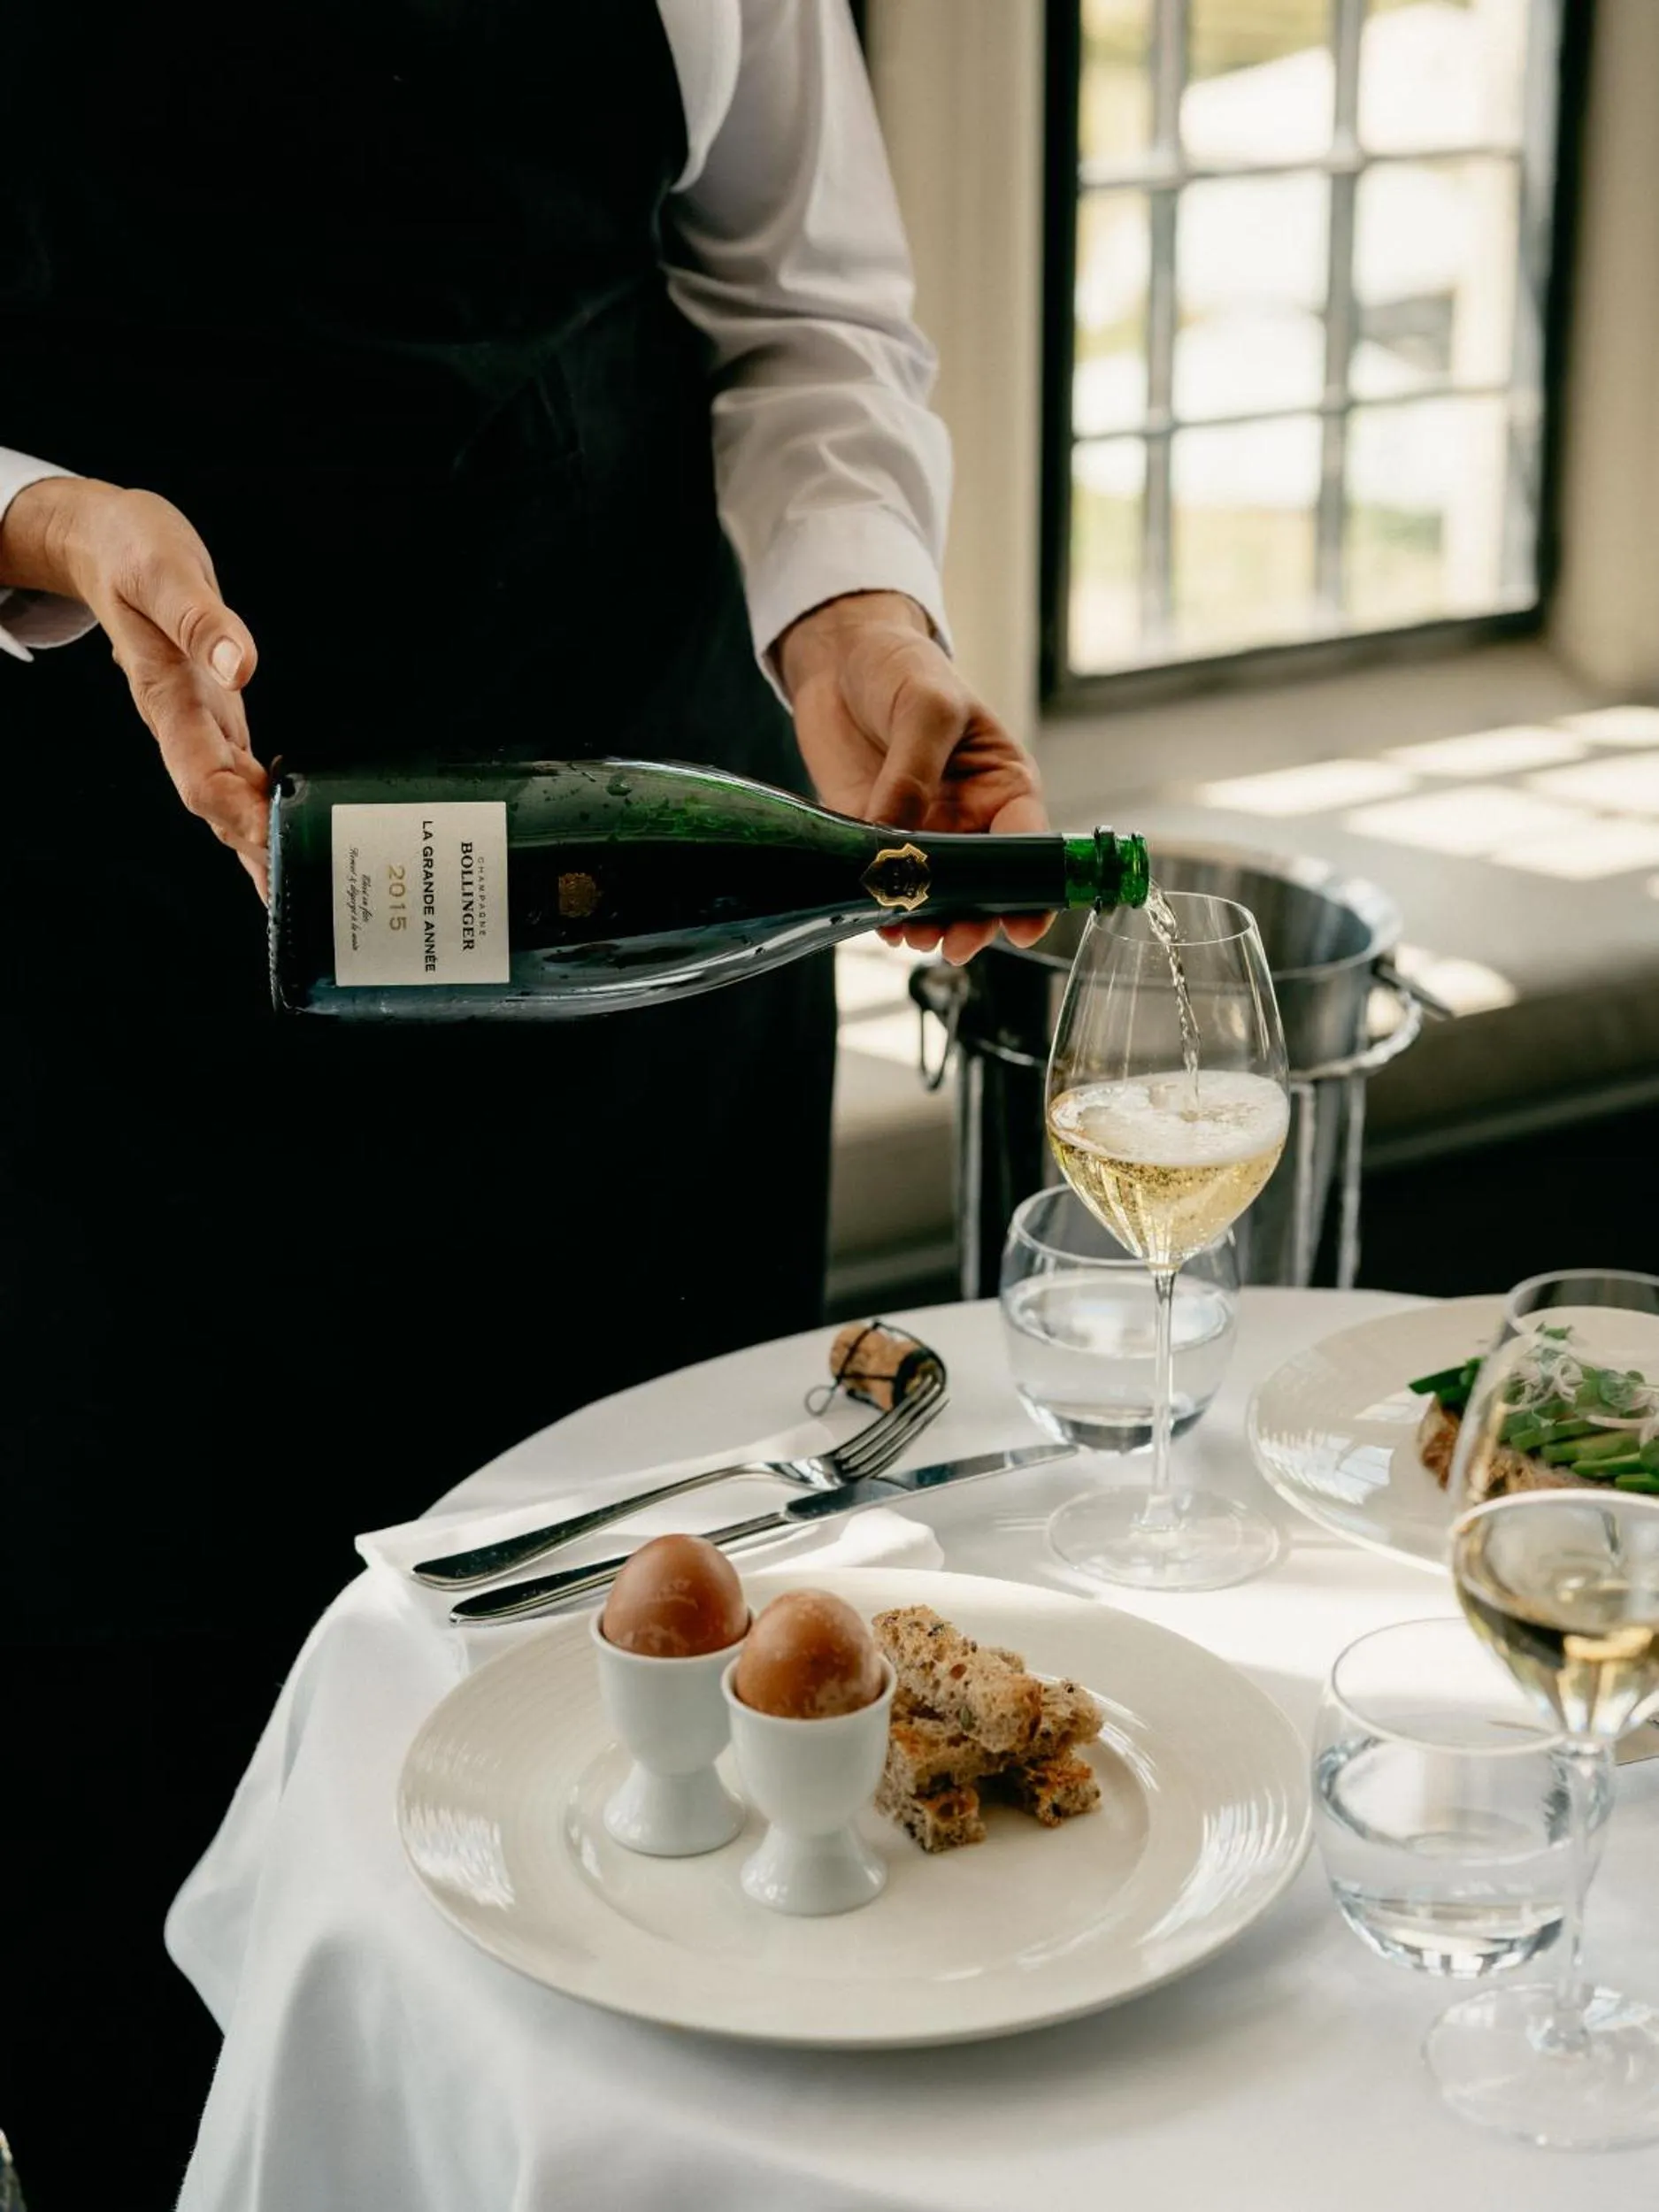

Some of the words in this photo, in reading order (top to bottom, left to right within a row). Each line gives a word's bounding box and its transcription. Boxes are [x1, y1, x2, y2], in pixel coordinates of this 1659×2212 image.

[422, 820, 434, 841] LA
[388, 864, 407, 931] 2015
[422, 846, 434, 916] GRANDE
[461, 841, 475, 951] BOLLINGER
[478, 856, 487, 936] CHAMPAGNE
[424, 921, 438, 972] ANNÉE
